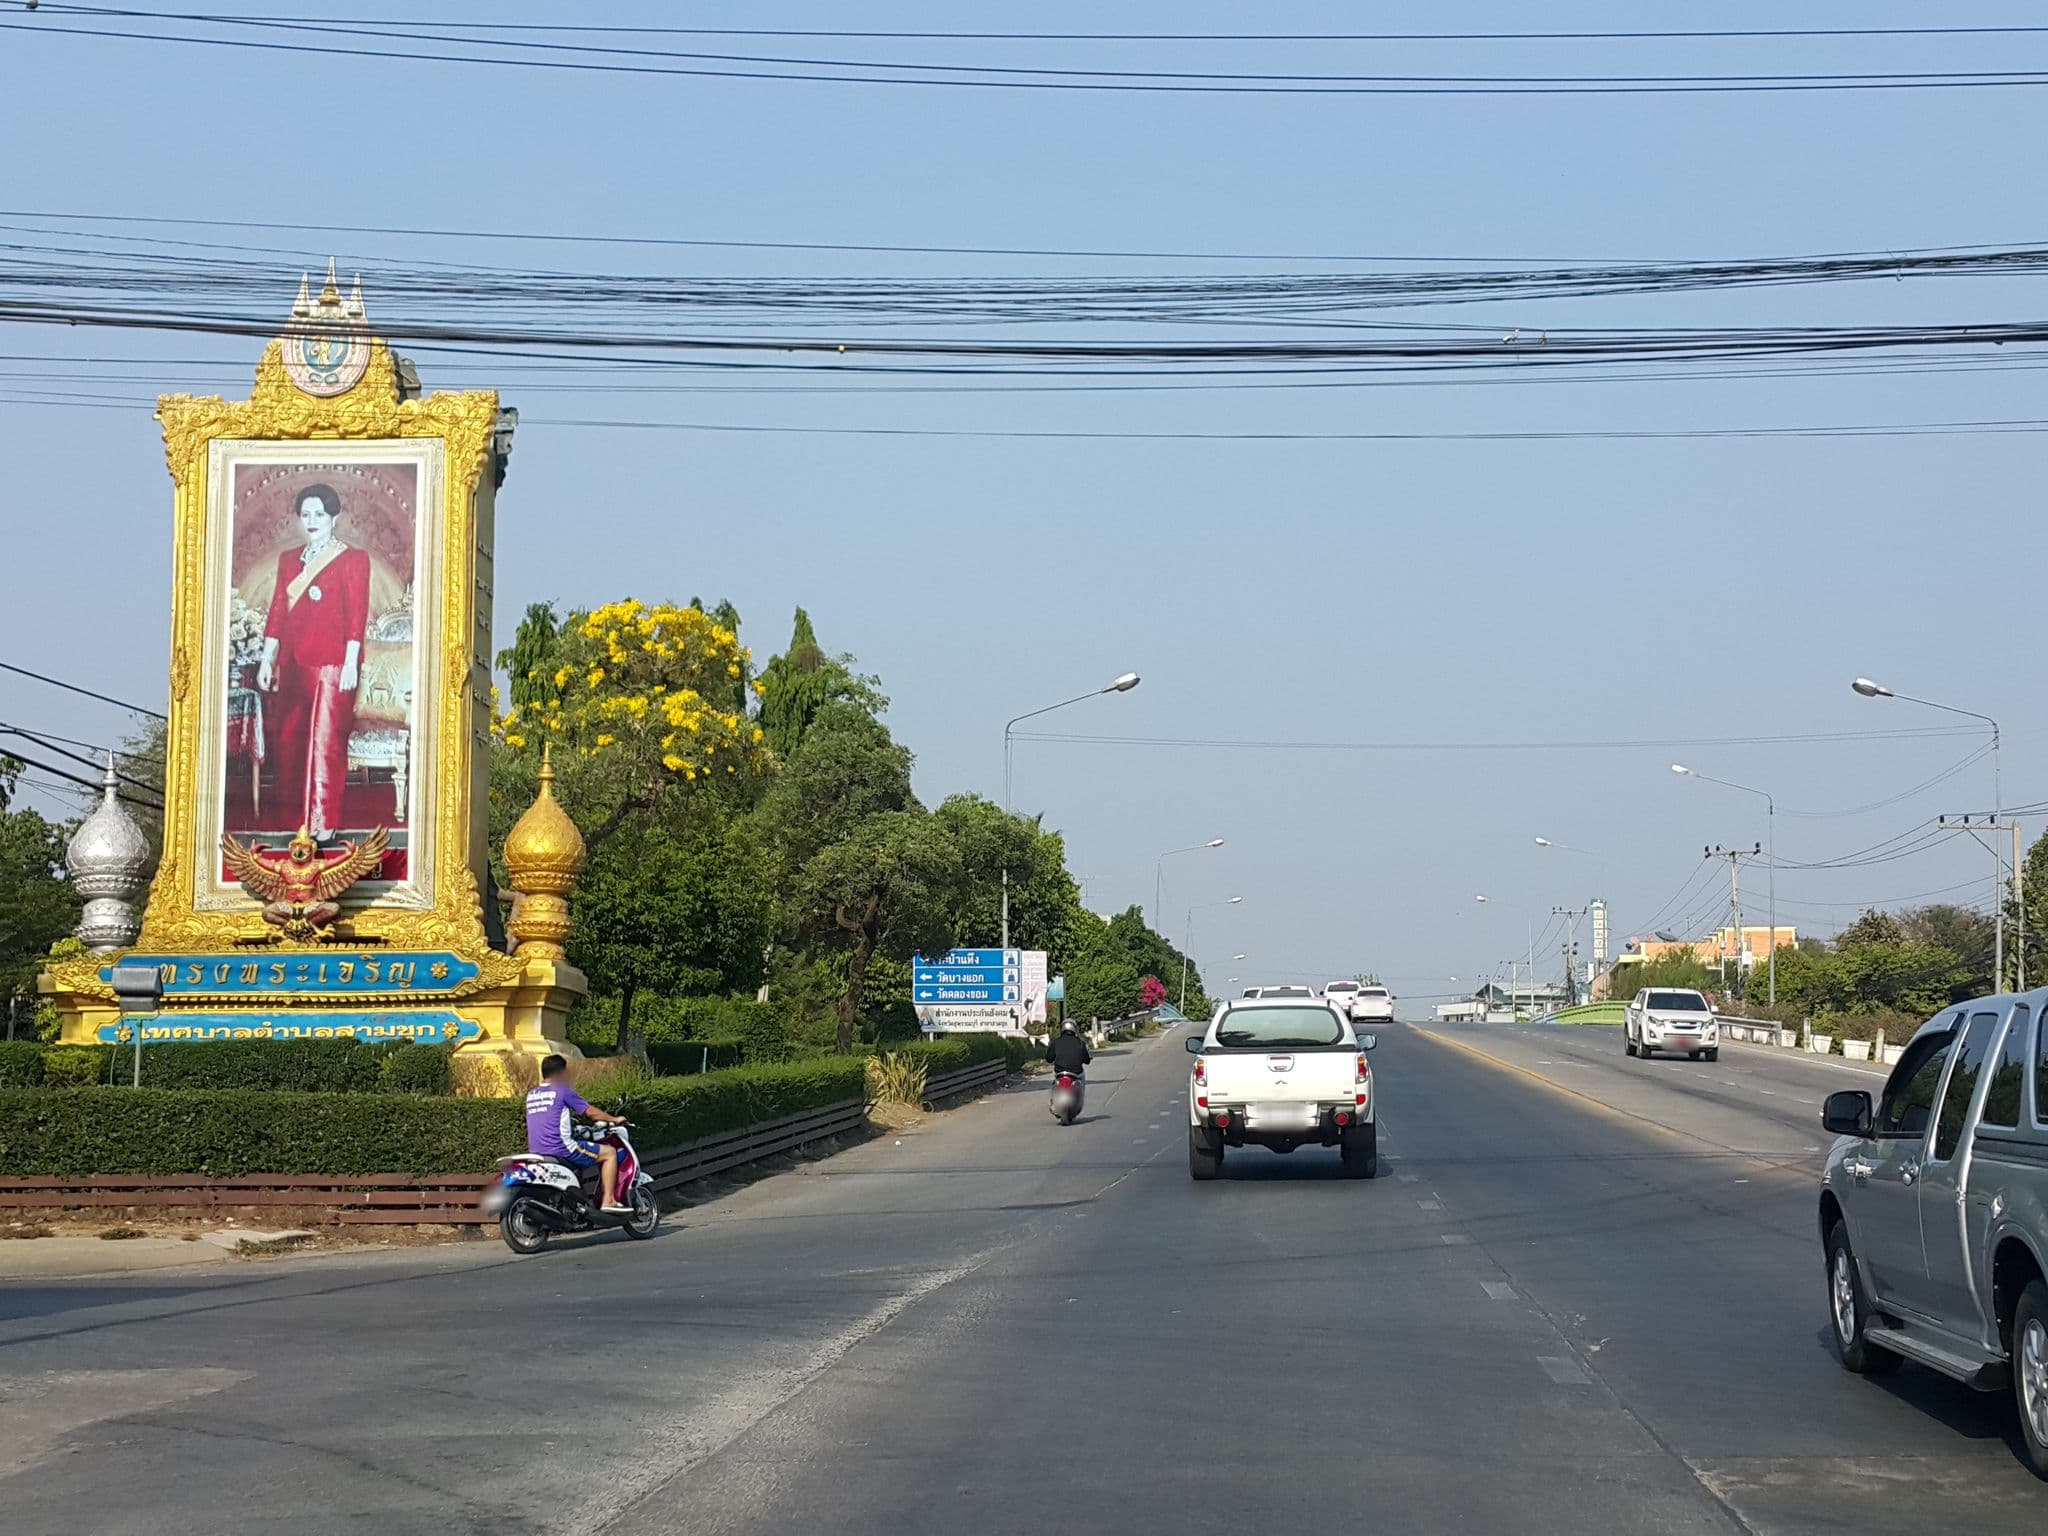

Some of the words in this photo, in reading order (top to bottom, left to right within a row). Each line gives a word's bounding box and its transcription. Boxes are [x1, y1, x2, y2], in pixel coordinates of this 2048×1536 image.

[159, 953, 417, 989] ทรงพระเจริญ
[141, 1021, 436, 1040] เทศบาลตำบลสามชุก
